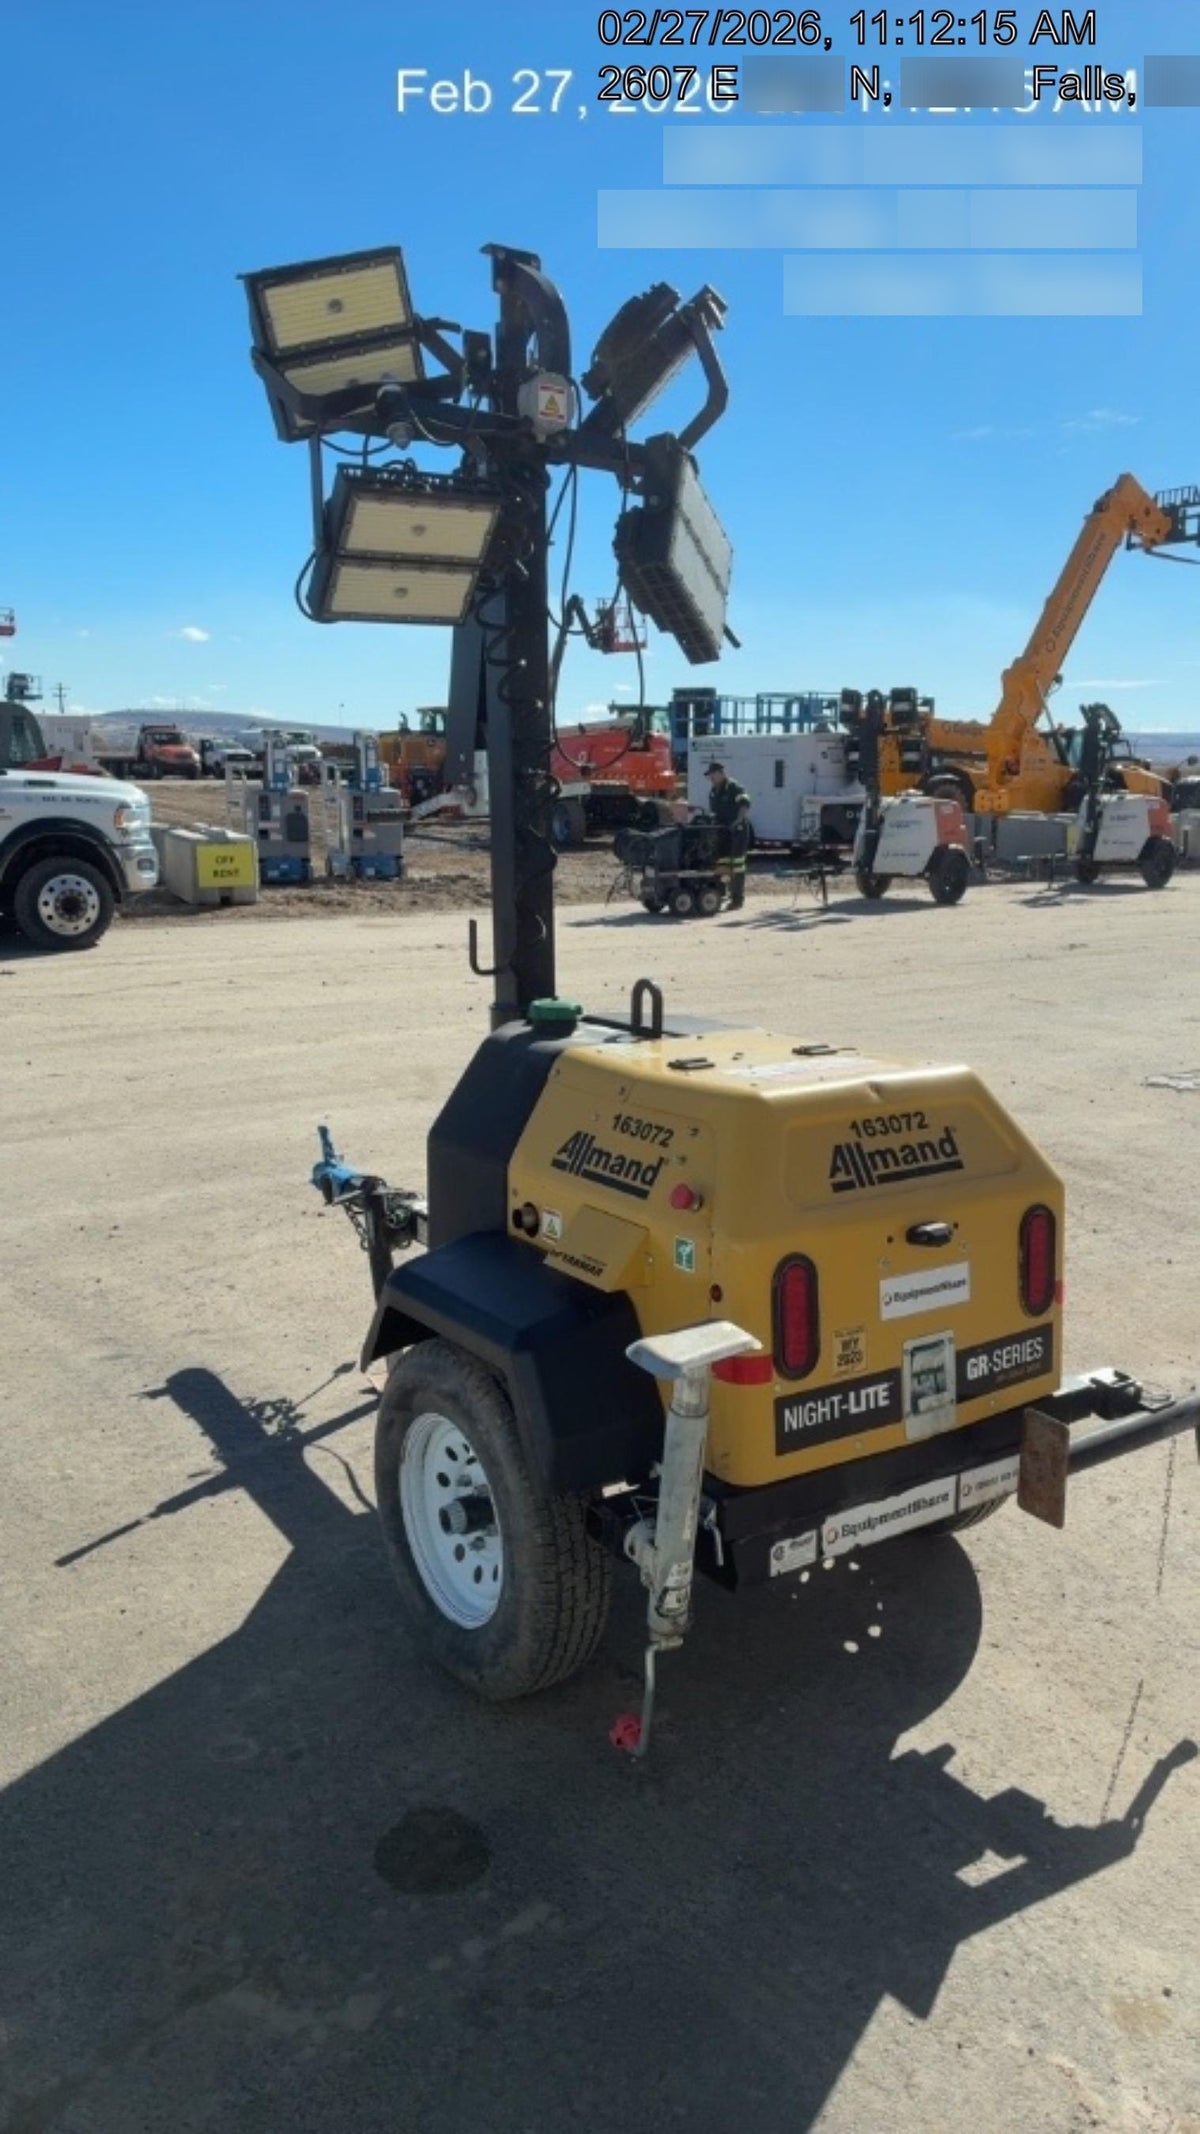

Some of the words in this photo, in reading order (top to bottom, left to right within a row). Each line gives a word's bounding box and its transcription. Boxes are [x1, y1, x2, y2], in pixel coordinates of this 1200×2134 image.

[612, 1112, 674, 1148] 163072
[849, 1111, 929, 1139] 163072
[554, 1130, 665, 1190] Allmand
[829, 1125, 960, 1188] Allmand
[784, 1382, 891, 1433] NIGHT-LITE
[840, 1490, 950, 1538] EquipmentShare
